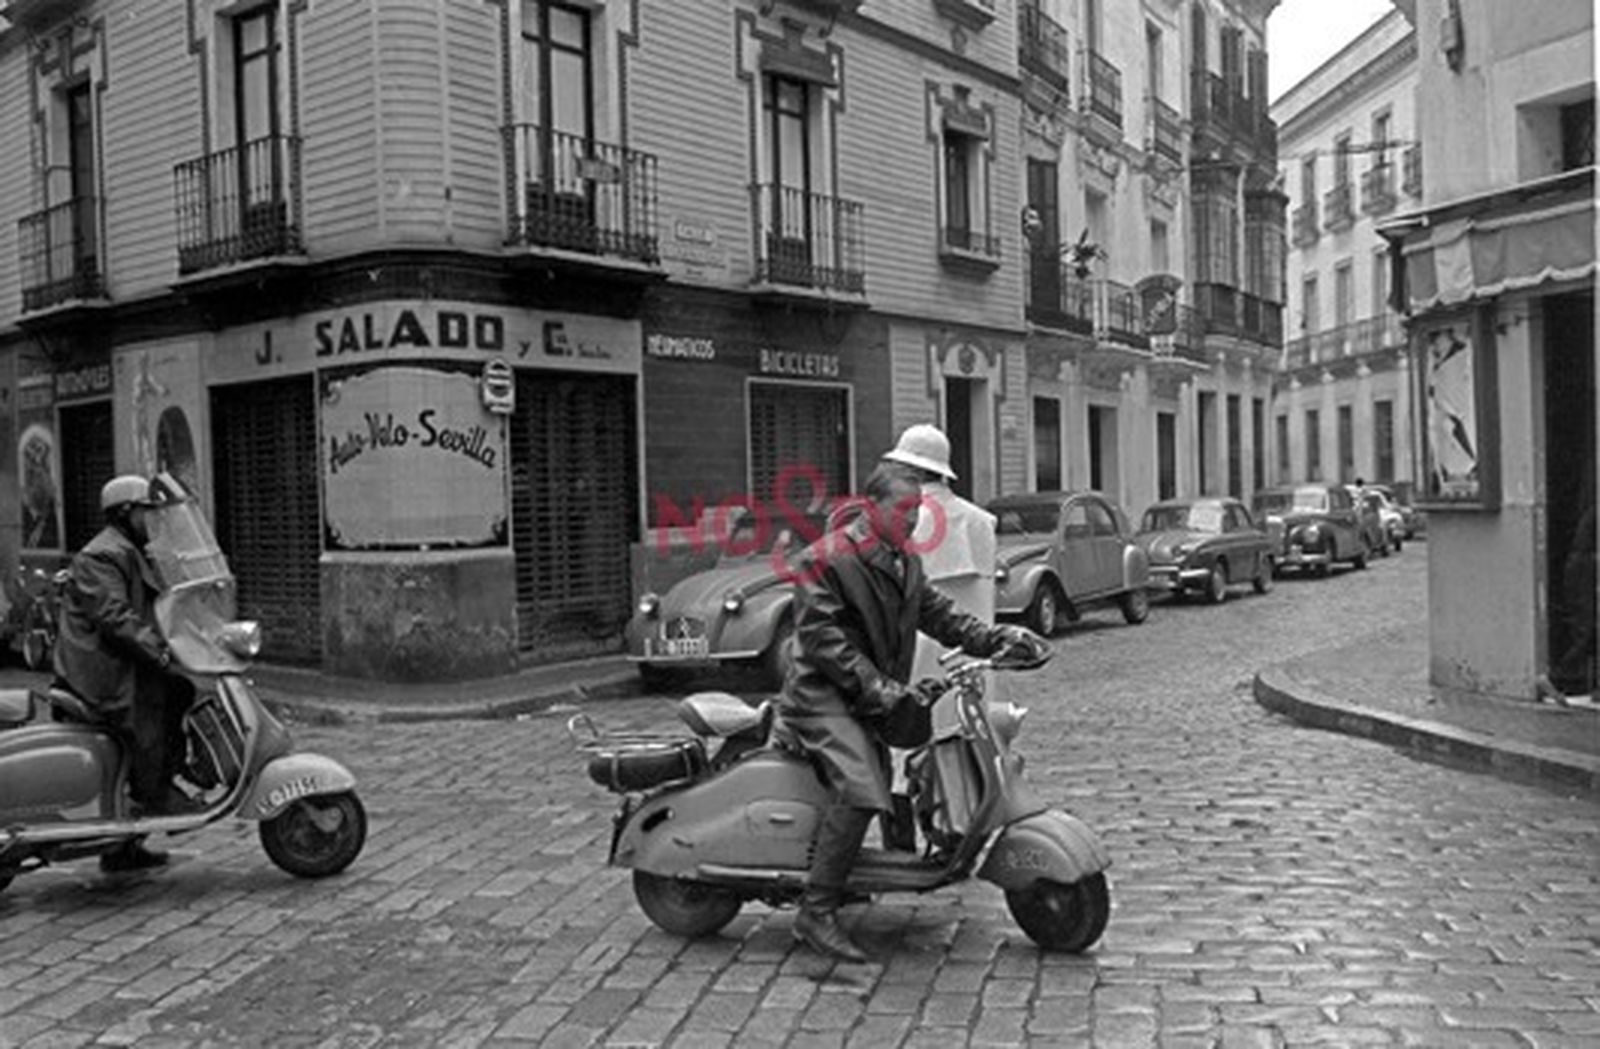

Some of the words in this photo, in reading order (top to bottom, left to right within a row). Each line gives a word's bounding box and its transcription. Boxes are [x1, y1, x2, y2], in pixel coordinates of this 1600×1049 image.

[255, 320, 282, 365] J.
[315, 309, 504, 357] SALADO
[516, 341, 531, 358] y
[760, 349, 840, 376] BICICLETAS
